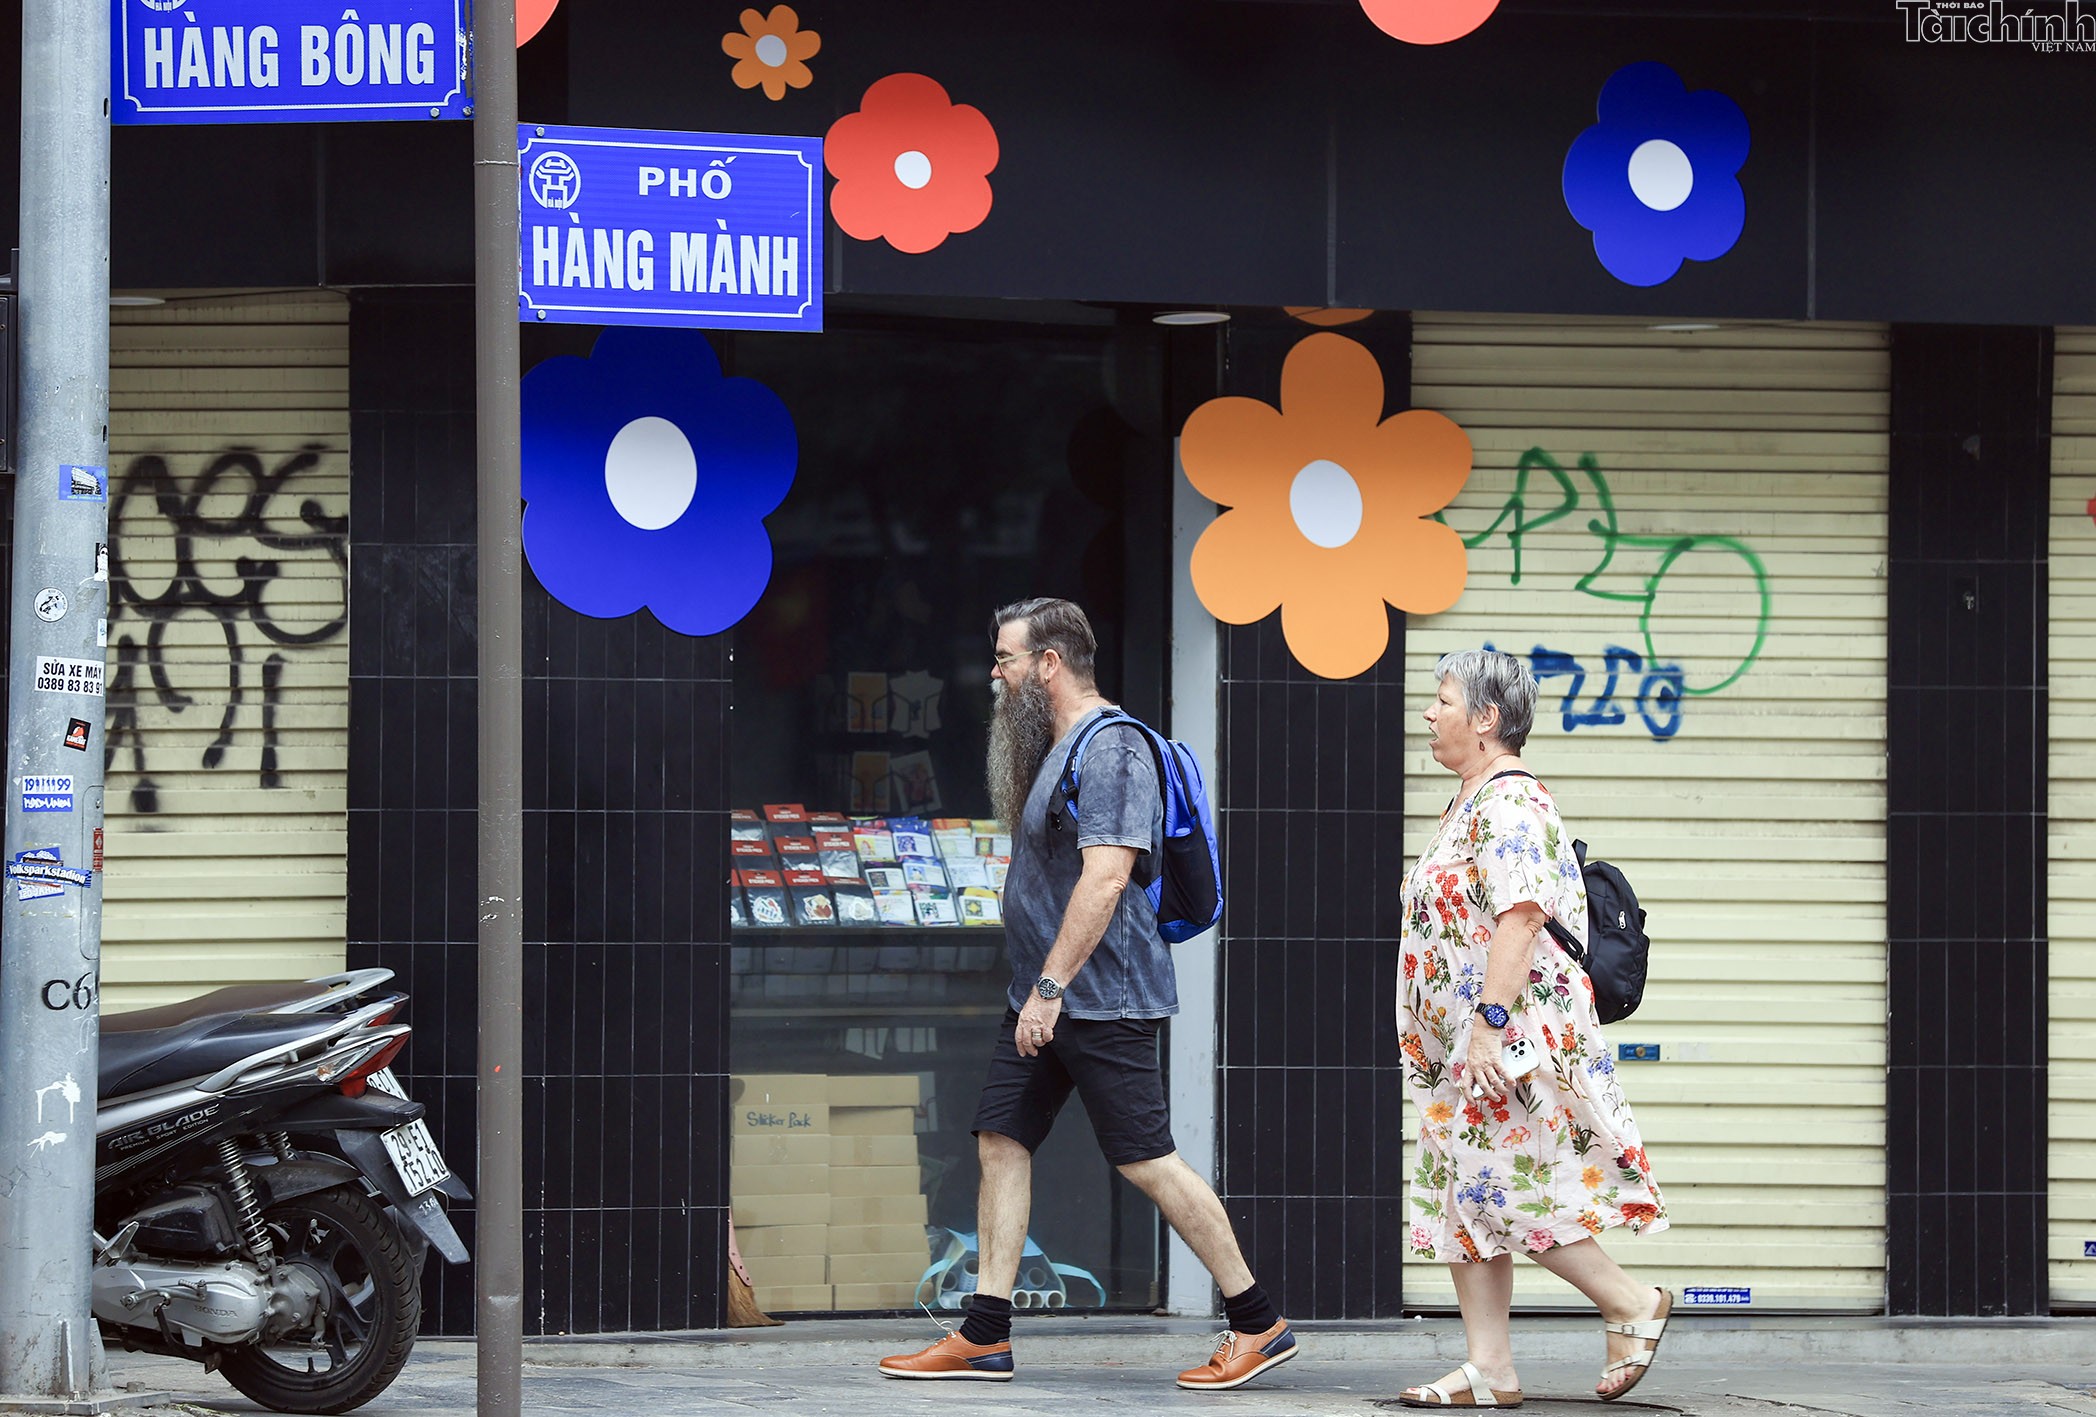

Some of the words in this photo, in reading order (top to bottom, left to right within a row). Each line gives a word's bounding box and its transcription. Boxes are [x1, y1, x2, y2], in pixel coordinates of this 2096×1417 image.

[144, 11, 279, 89] HÀNG
[300, 9, 436, 86] BÔNG
[637, 156, 738, 200] PHỐ
[532, 212, 654, 292] HÀNG
[669, 219, 799, 297] MÀNH
[38, 676, 64, 691] 0389
[68, 679, 80, 692] 83
[83, 680, 94, 693] 83
[43, 658, 65, 676] SỬA
[69, 664, 82, 677] XE
[85, 664, 102, 679] MÁY
[107, 1130, 145, 1150] AIR
[147, 1103, 219, 1136] BLADE
[788, 1111, 811, 1128] Pack
